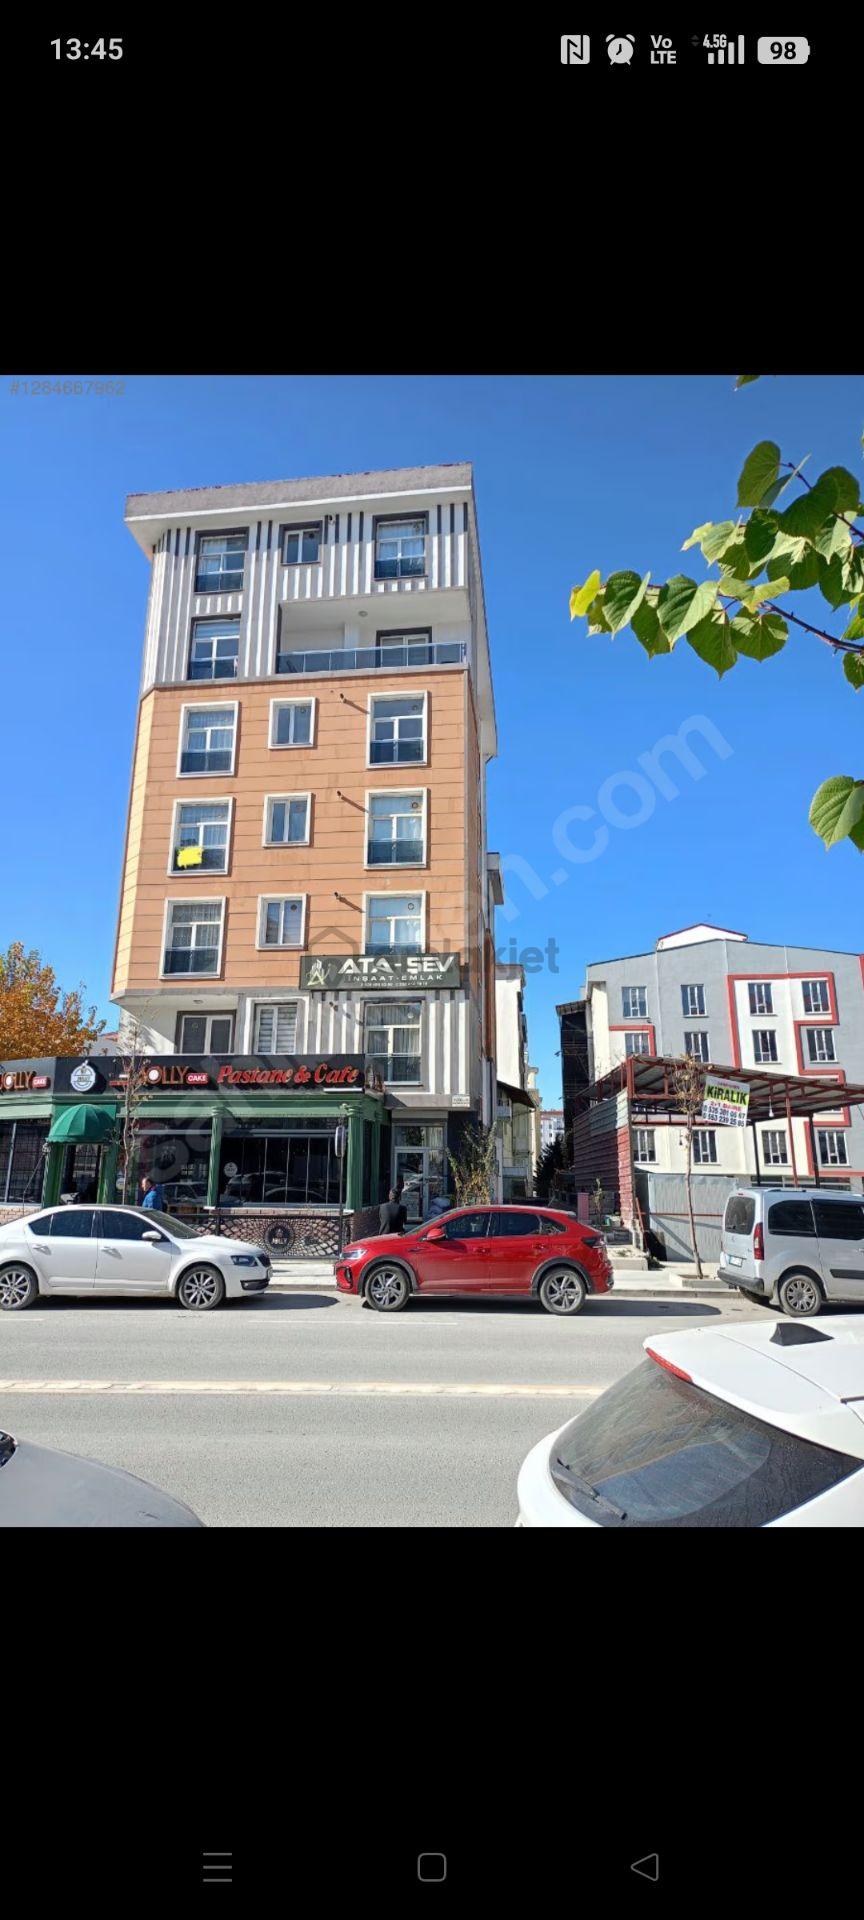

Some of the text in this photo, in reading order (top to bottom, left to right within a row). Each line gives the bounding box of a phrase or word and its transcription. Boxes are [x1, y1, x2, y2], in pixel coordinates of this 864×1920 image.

[187, 1074, 208, 1083] CAKE
[216, 1062, 359, 1084] Pastane & Cafe
